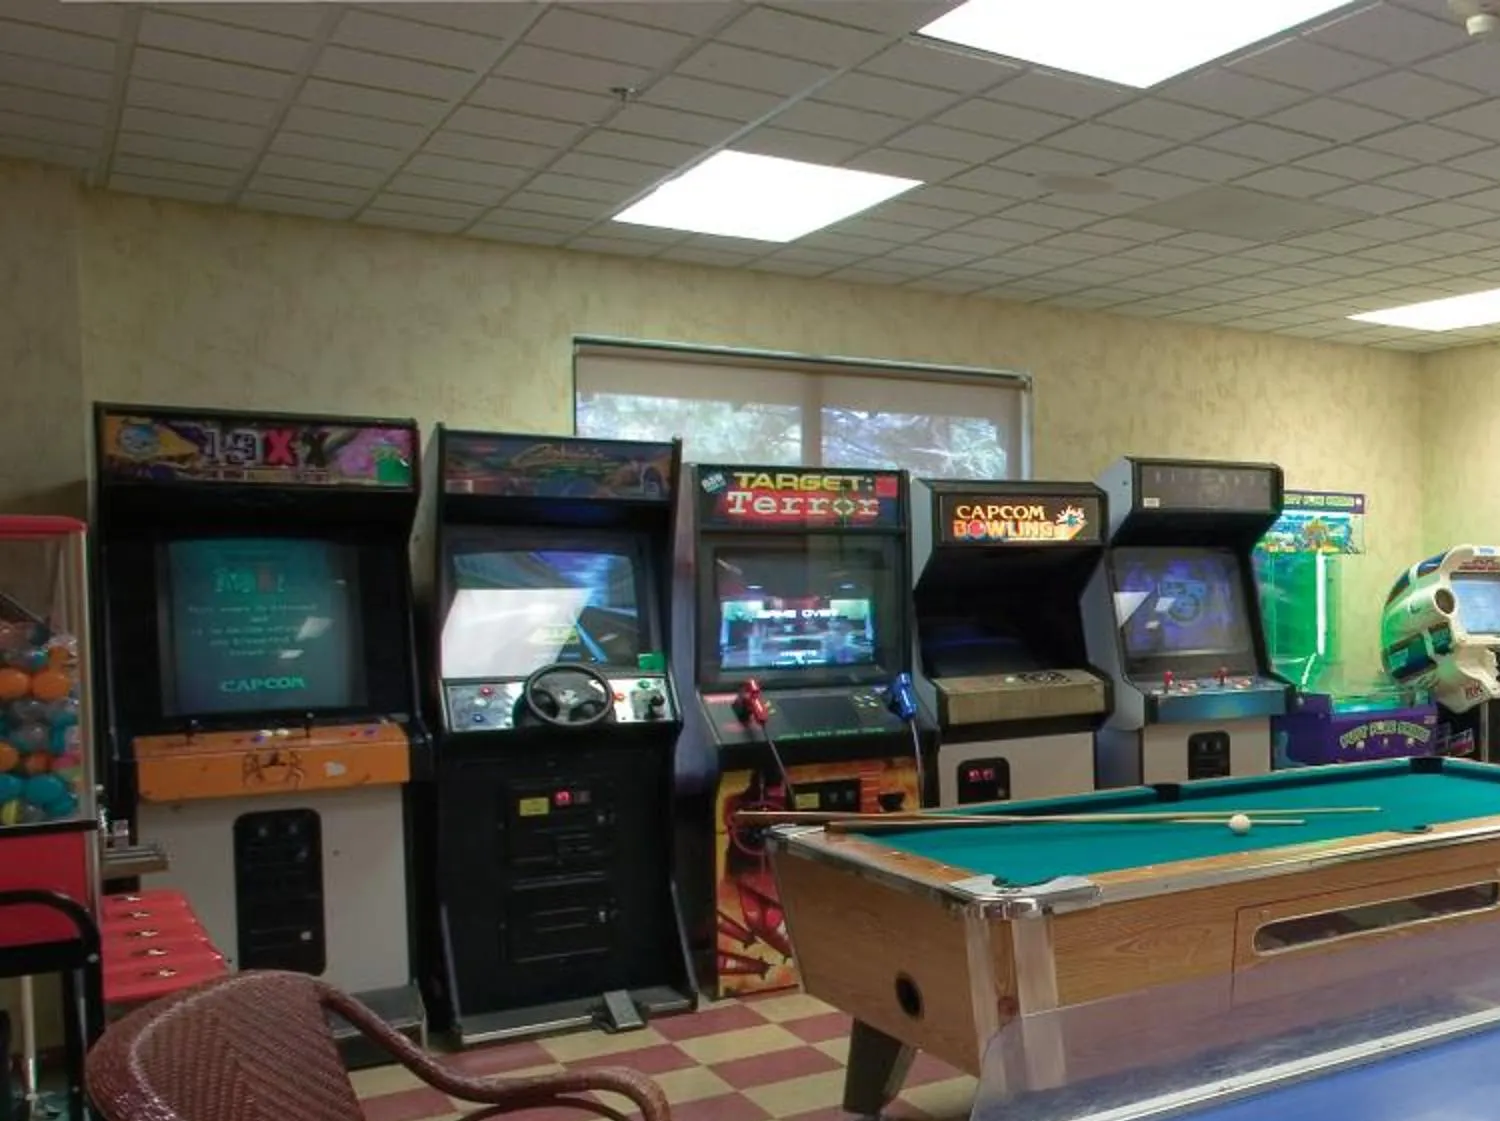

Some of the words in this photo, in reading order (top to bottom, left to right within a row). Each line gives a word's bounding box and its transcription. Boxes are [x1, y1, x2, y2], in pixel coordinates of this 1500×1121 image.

[203, 427, 328, 468] 19XX
[733, 472, 875, 491] TARGET:
[727, 491, 881, 515] Terror
[956, 505, 1046, 520] CAPCOM
[953, 520, 1055, 538] BOWLING
[219, 676, 306, 692] CAPCOM
